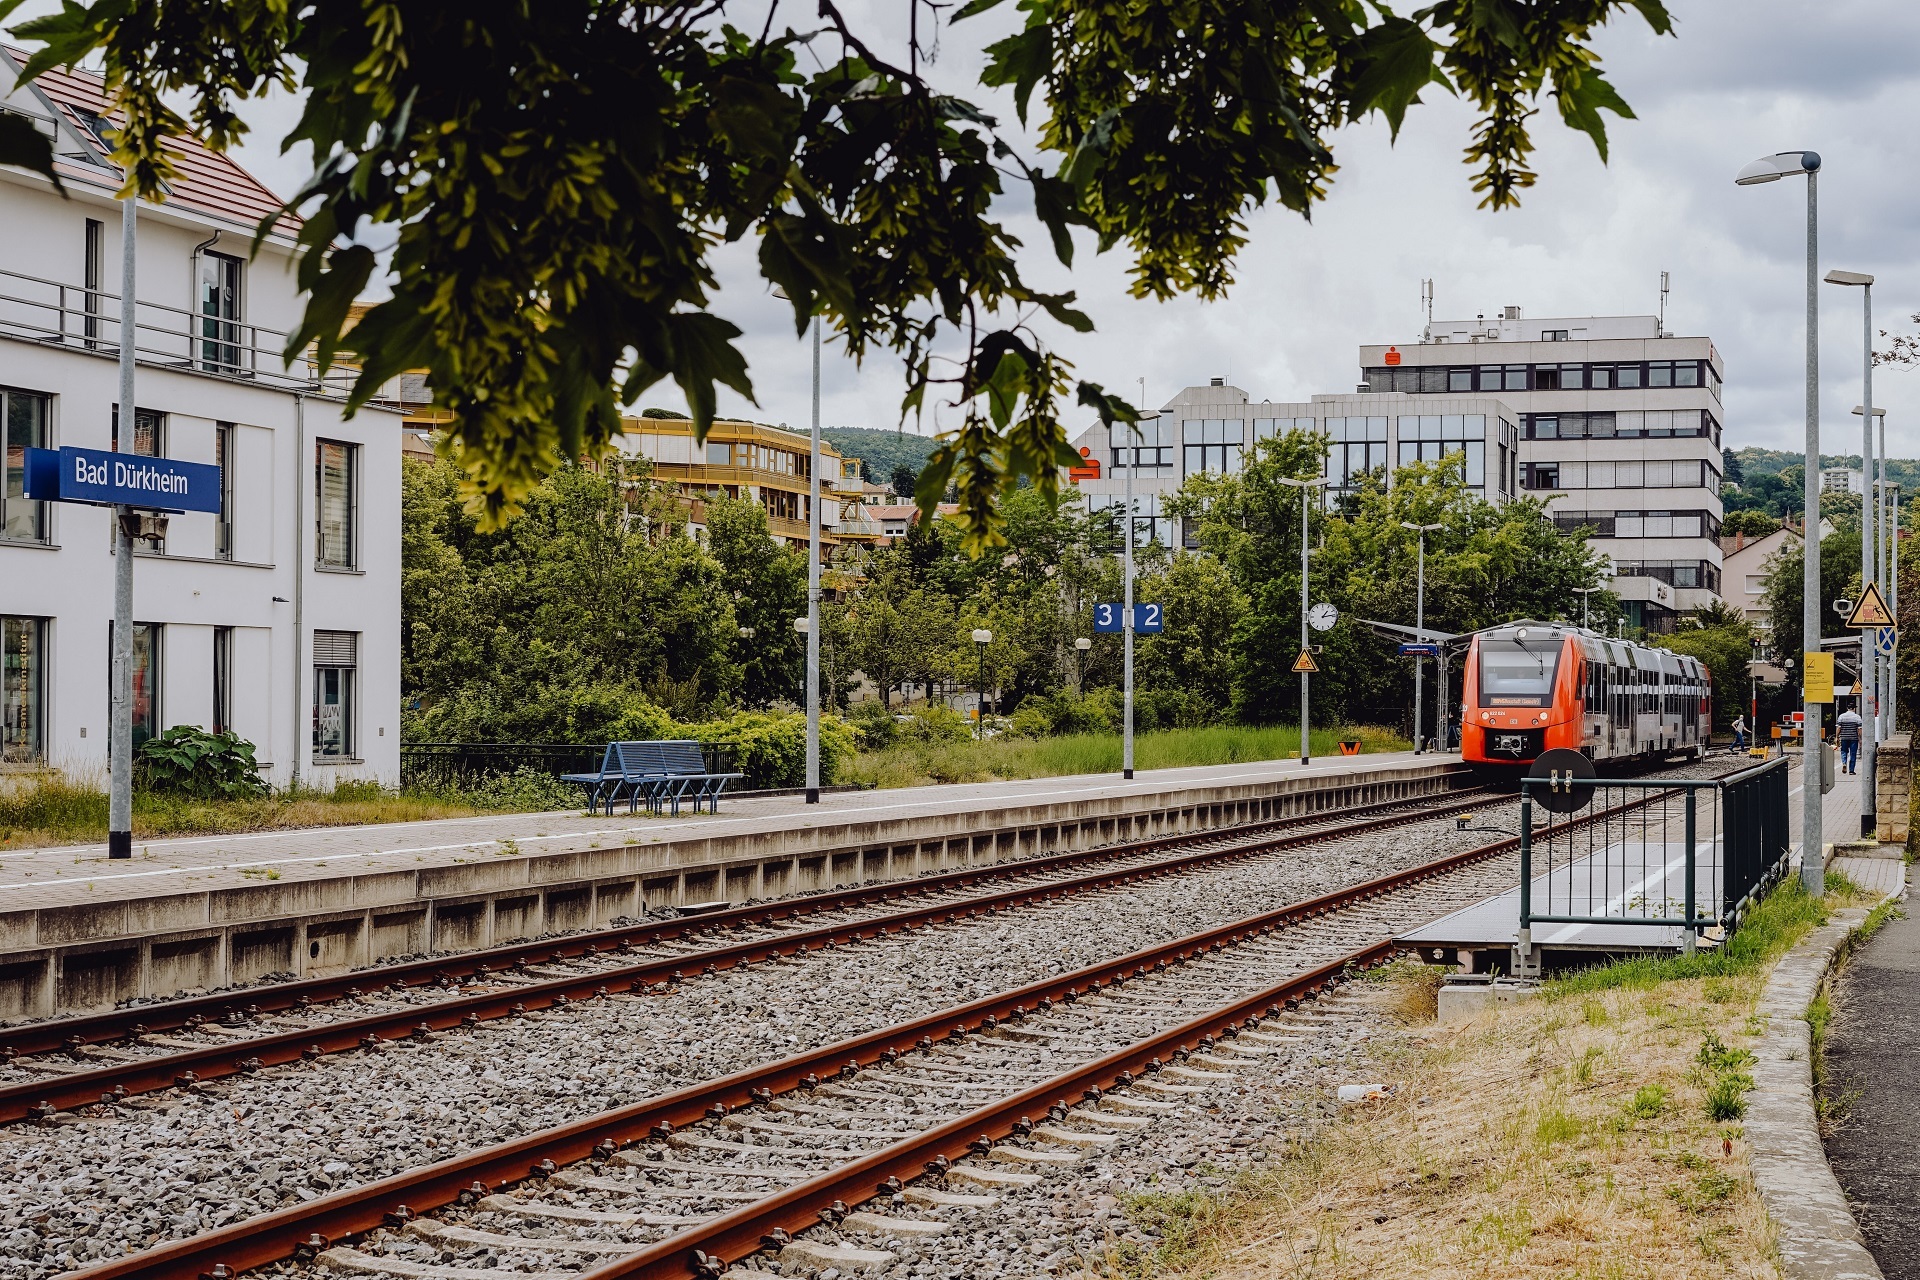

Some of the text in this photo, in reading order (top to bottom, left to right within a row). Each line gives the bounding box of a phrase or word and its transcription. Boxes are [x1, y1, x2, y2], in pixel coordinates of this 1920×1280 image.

[75, 456, 108, 486] Bad
[115, 461, 188, 495] Dürkheim
[1098, 603, 1159, 626] 3 2
[18, 634, 28, 747] Kosmetikinstitut
